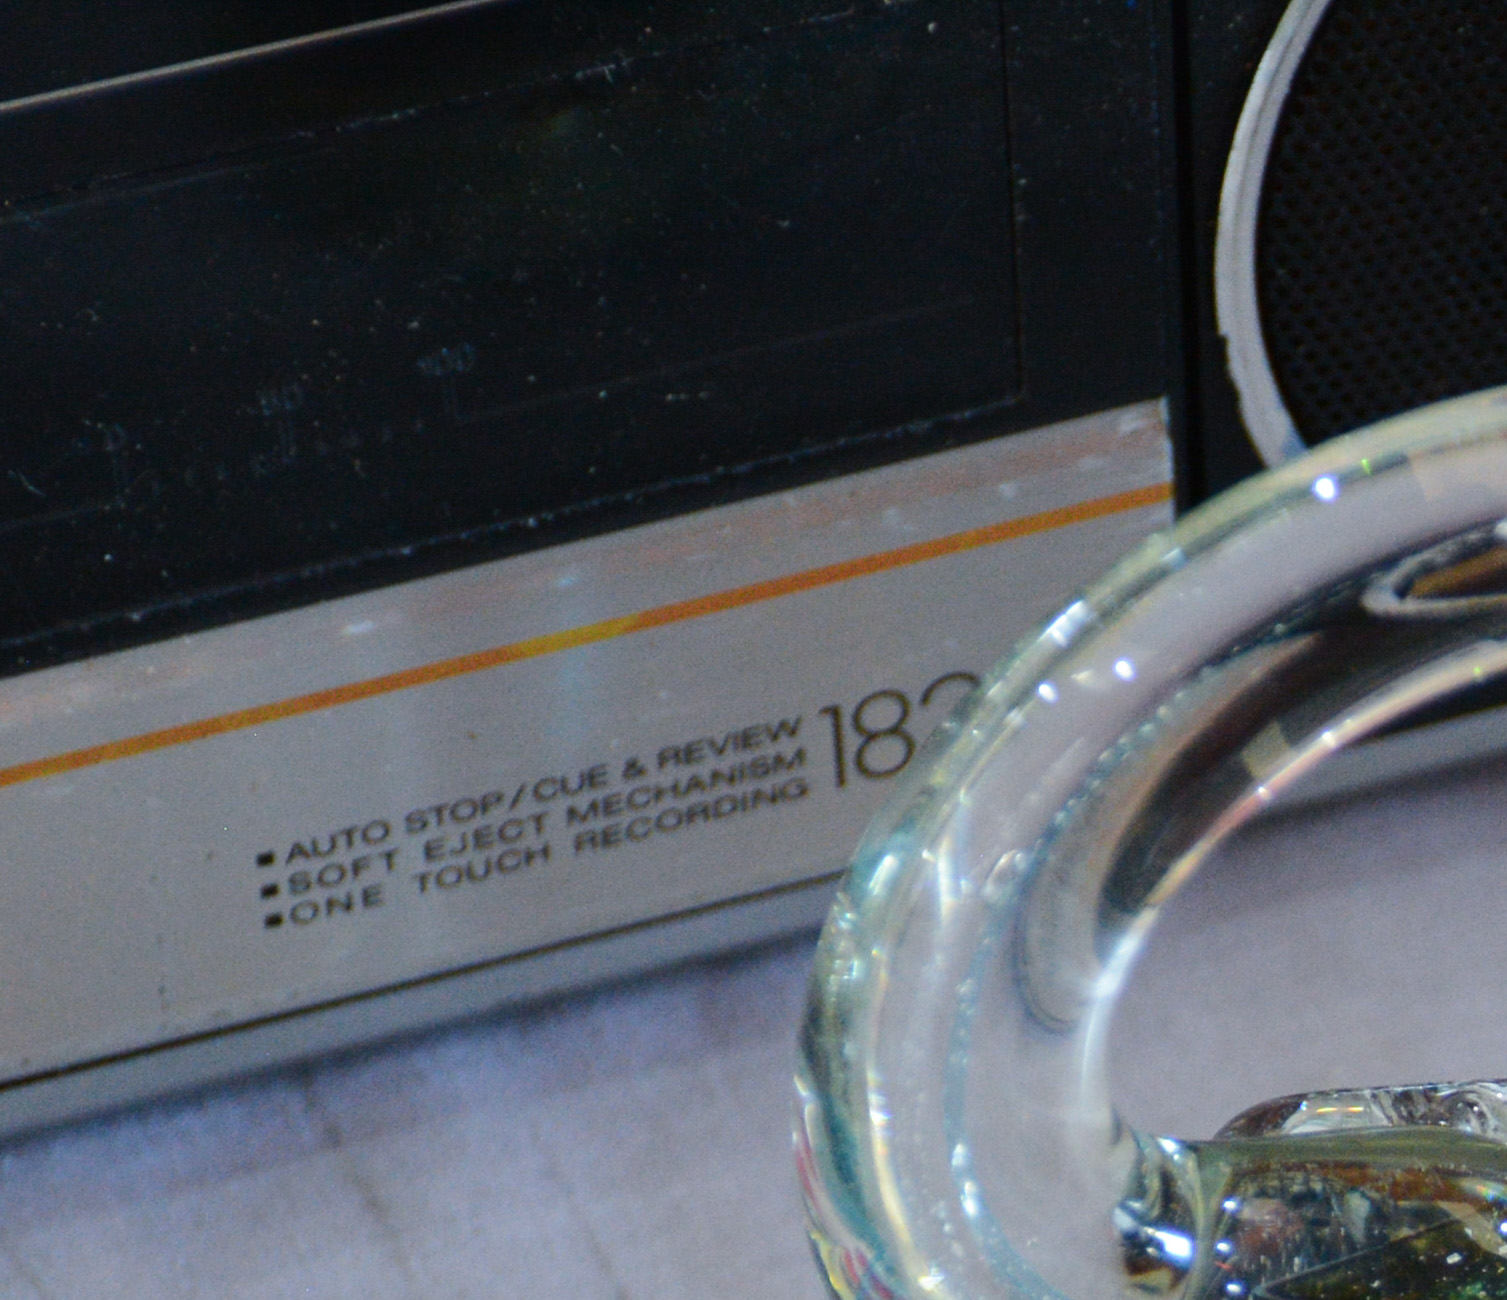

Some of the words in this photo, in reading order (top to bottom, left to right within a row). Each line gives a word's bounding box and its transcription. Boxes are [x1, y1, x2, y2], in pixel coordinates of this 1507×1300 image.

[286, 819, 391, 865] AUTO
[404, 763, 607, 835] STOP/CUE
[622, 757, 648, 781] &
[656, 715, 801, 770] REVIEW
[288, 848, 398, 895] SOFT
[424, 811, 548, 862] EJECT
[565, 748, 807, 827] MECHANISM
[290, 884, 384, 925] ONE
[415, 843, 551, 894] TOUCH
[574, 777, 809, 855] RECORDING
